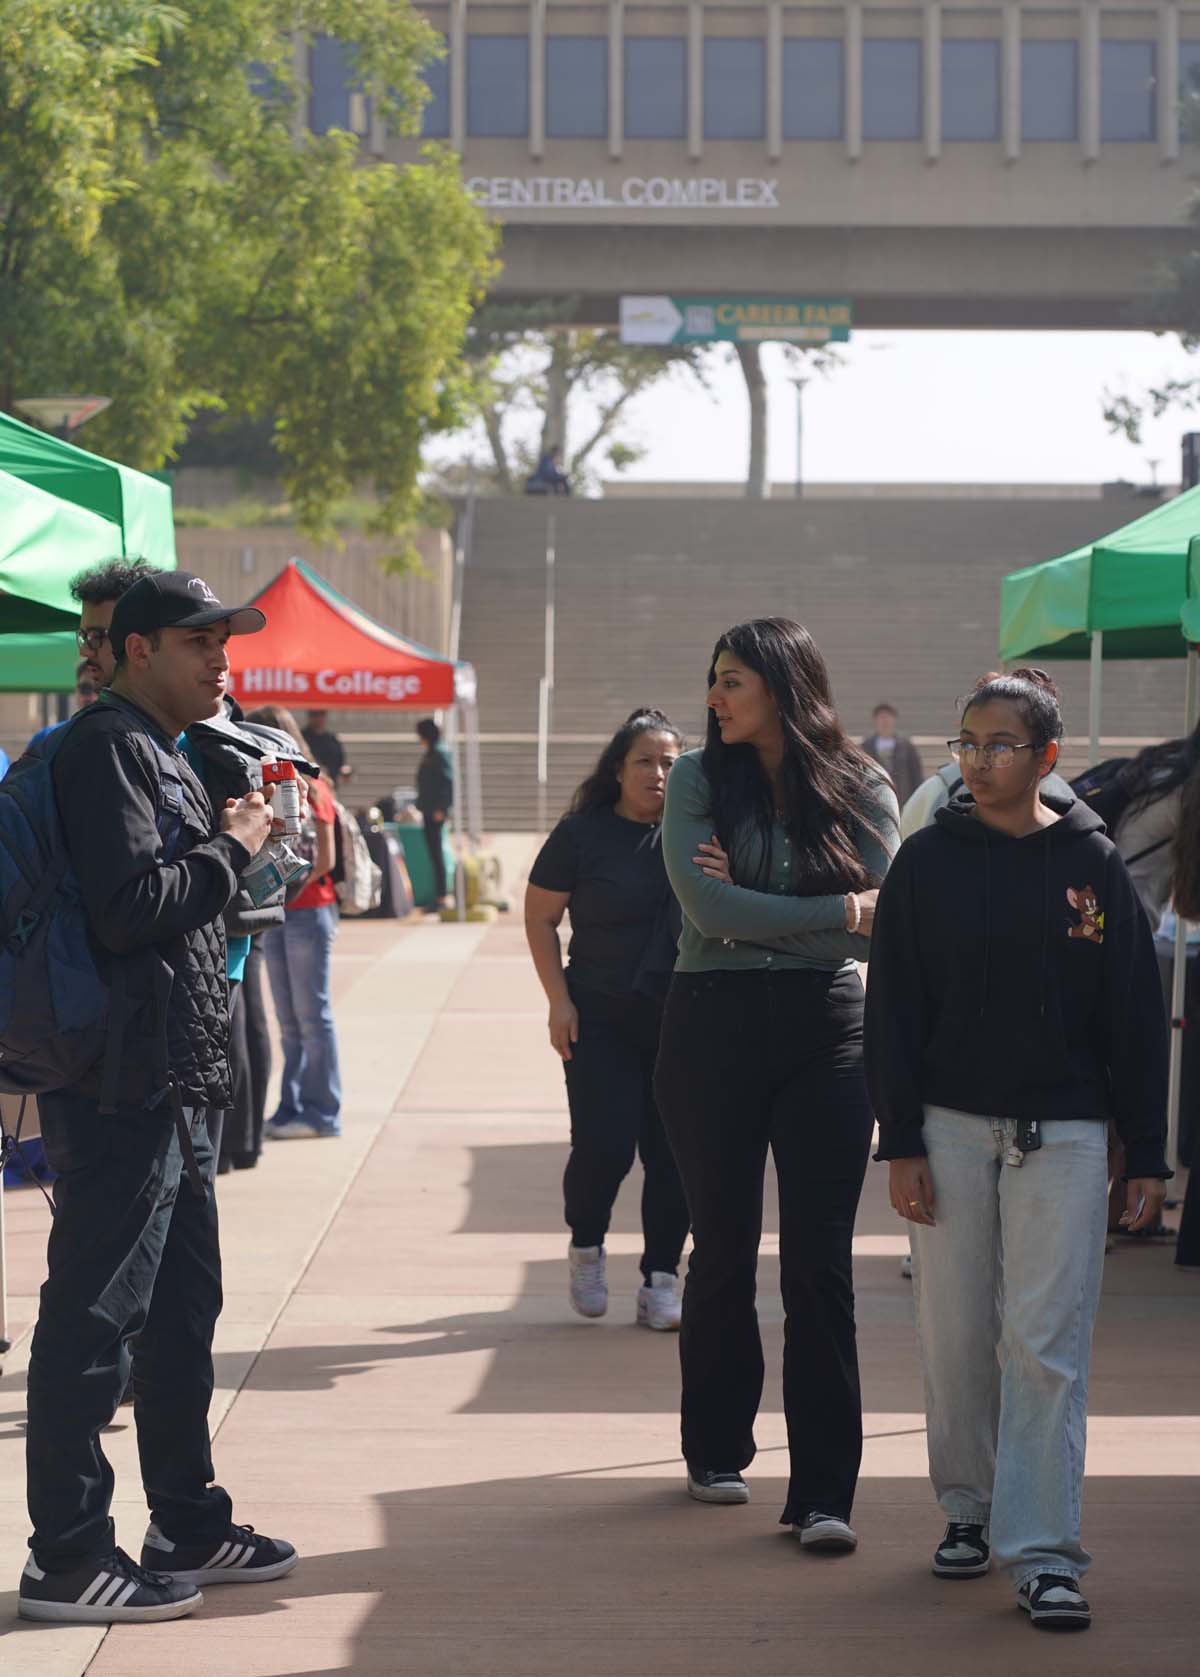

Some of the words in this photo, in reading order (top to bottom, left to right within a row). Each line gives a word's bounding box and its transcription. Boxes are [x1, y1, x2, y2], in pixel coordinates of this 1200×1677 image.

[466, 176, 613, 206] CENTRAL
[621, 176, 779, 207] COMPLEX
[716, 303, 800, 324] CAREER
[804, 304, 850, 324] FAIR
[243, 668, 309, 693] Hills
[315, 669, 421, 701] College
